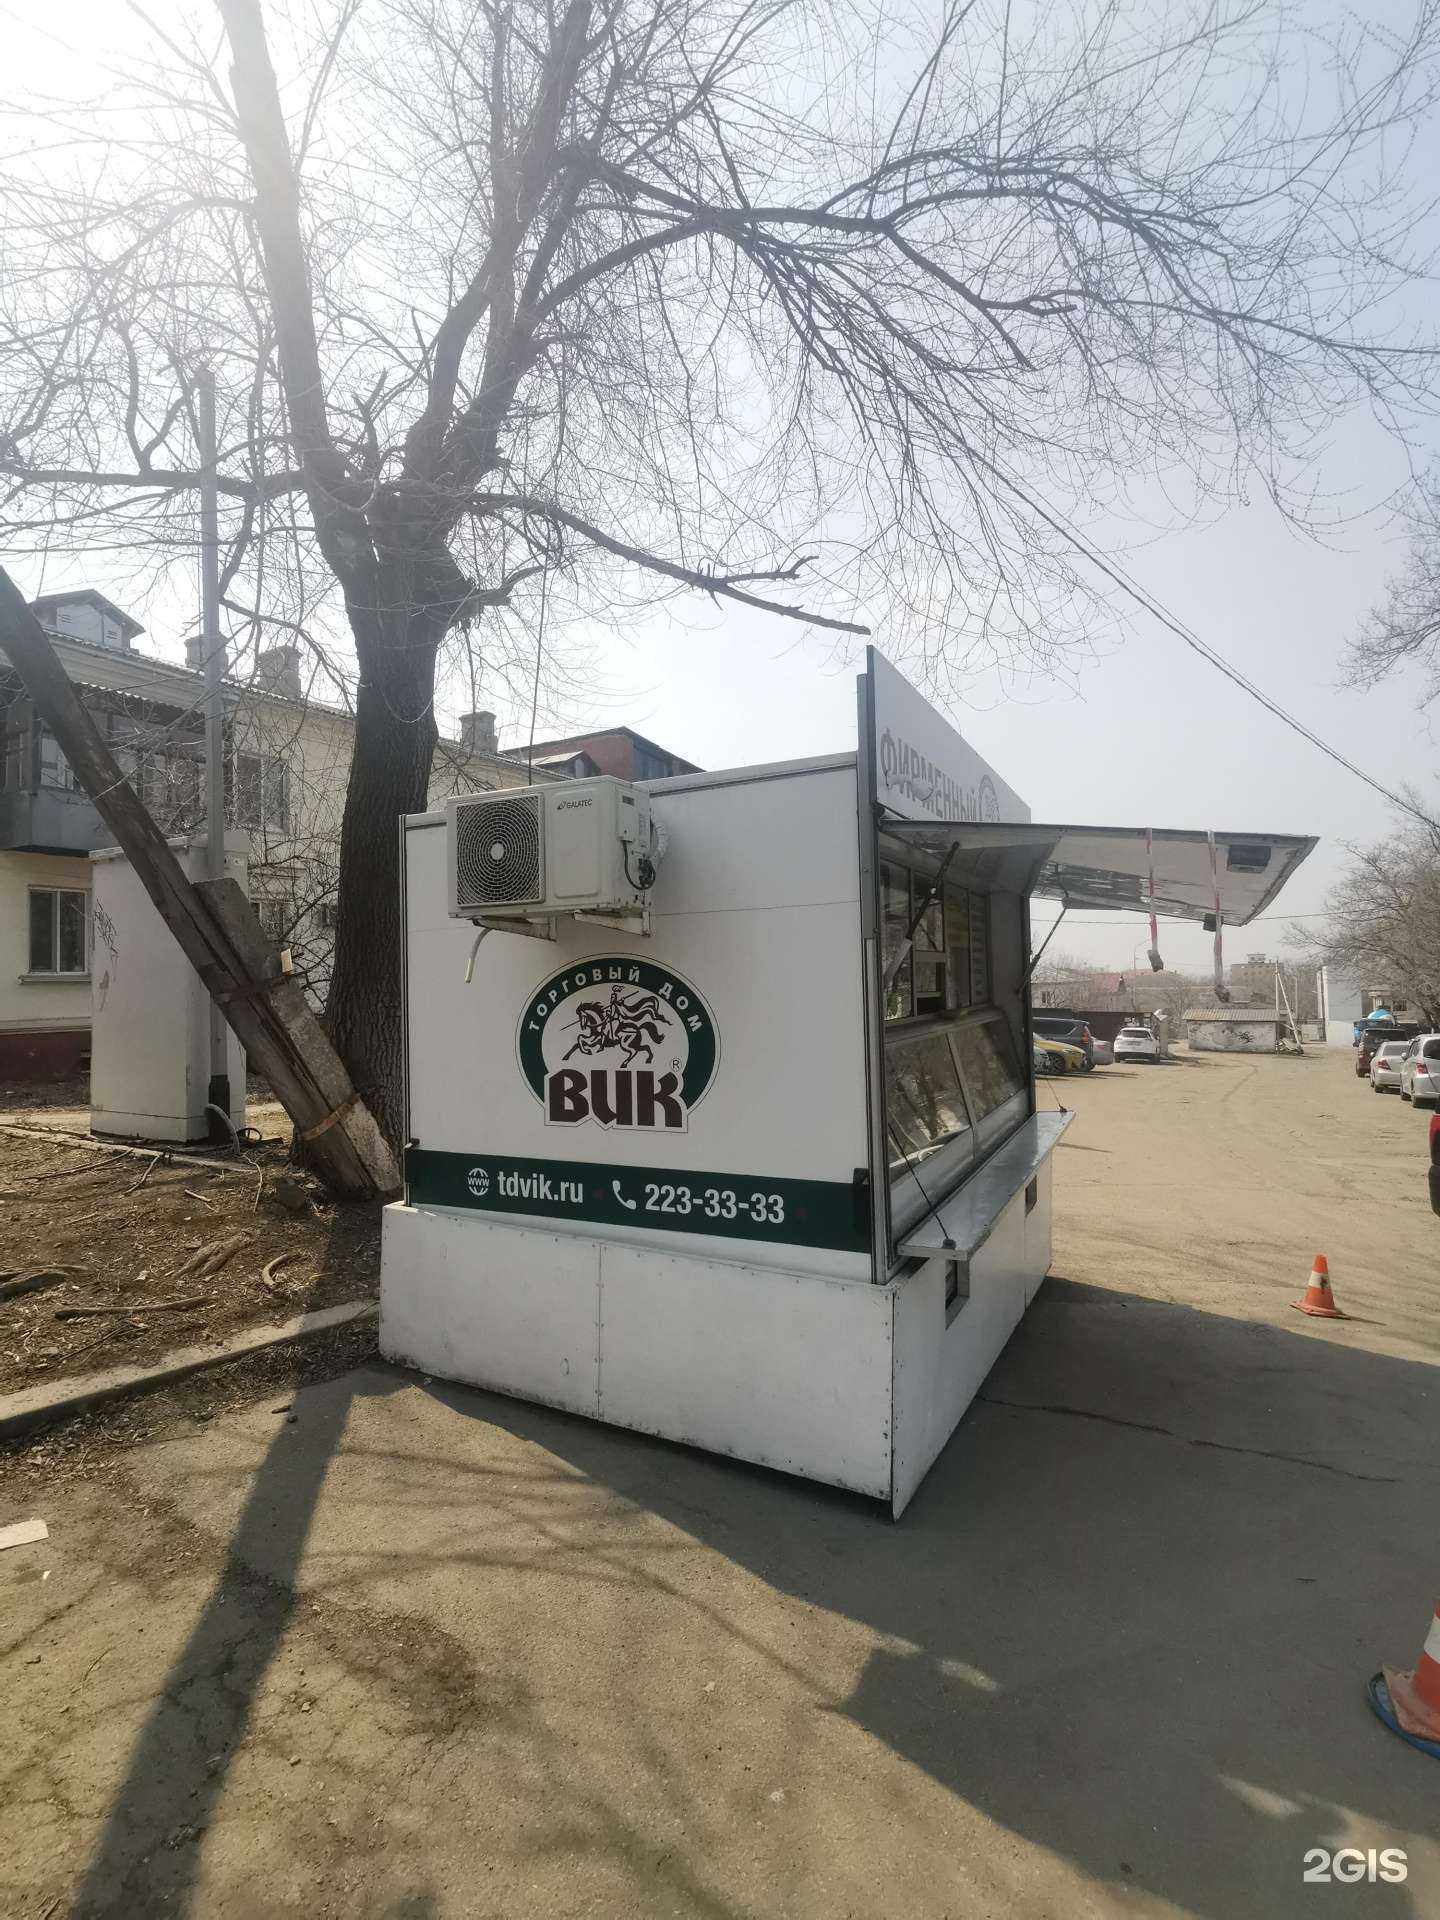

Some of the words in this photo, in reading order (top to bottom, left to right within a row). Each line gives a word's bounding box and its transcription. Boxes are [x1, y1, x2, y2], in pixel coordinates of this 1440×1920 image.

[528, 965, 640, 1032] ТОРГОВЫЙ
[657, 982, 703, 1032] ДОМ
[549, 1068, 683, 1128] ВИК
[497, 1170, 584, 1204] tdvik.ru
[644, 1183, 786, 1224] 223-33-33
